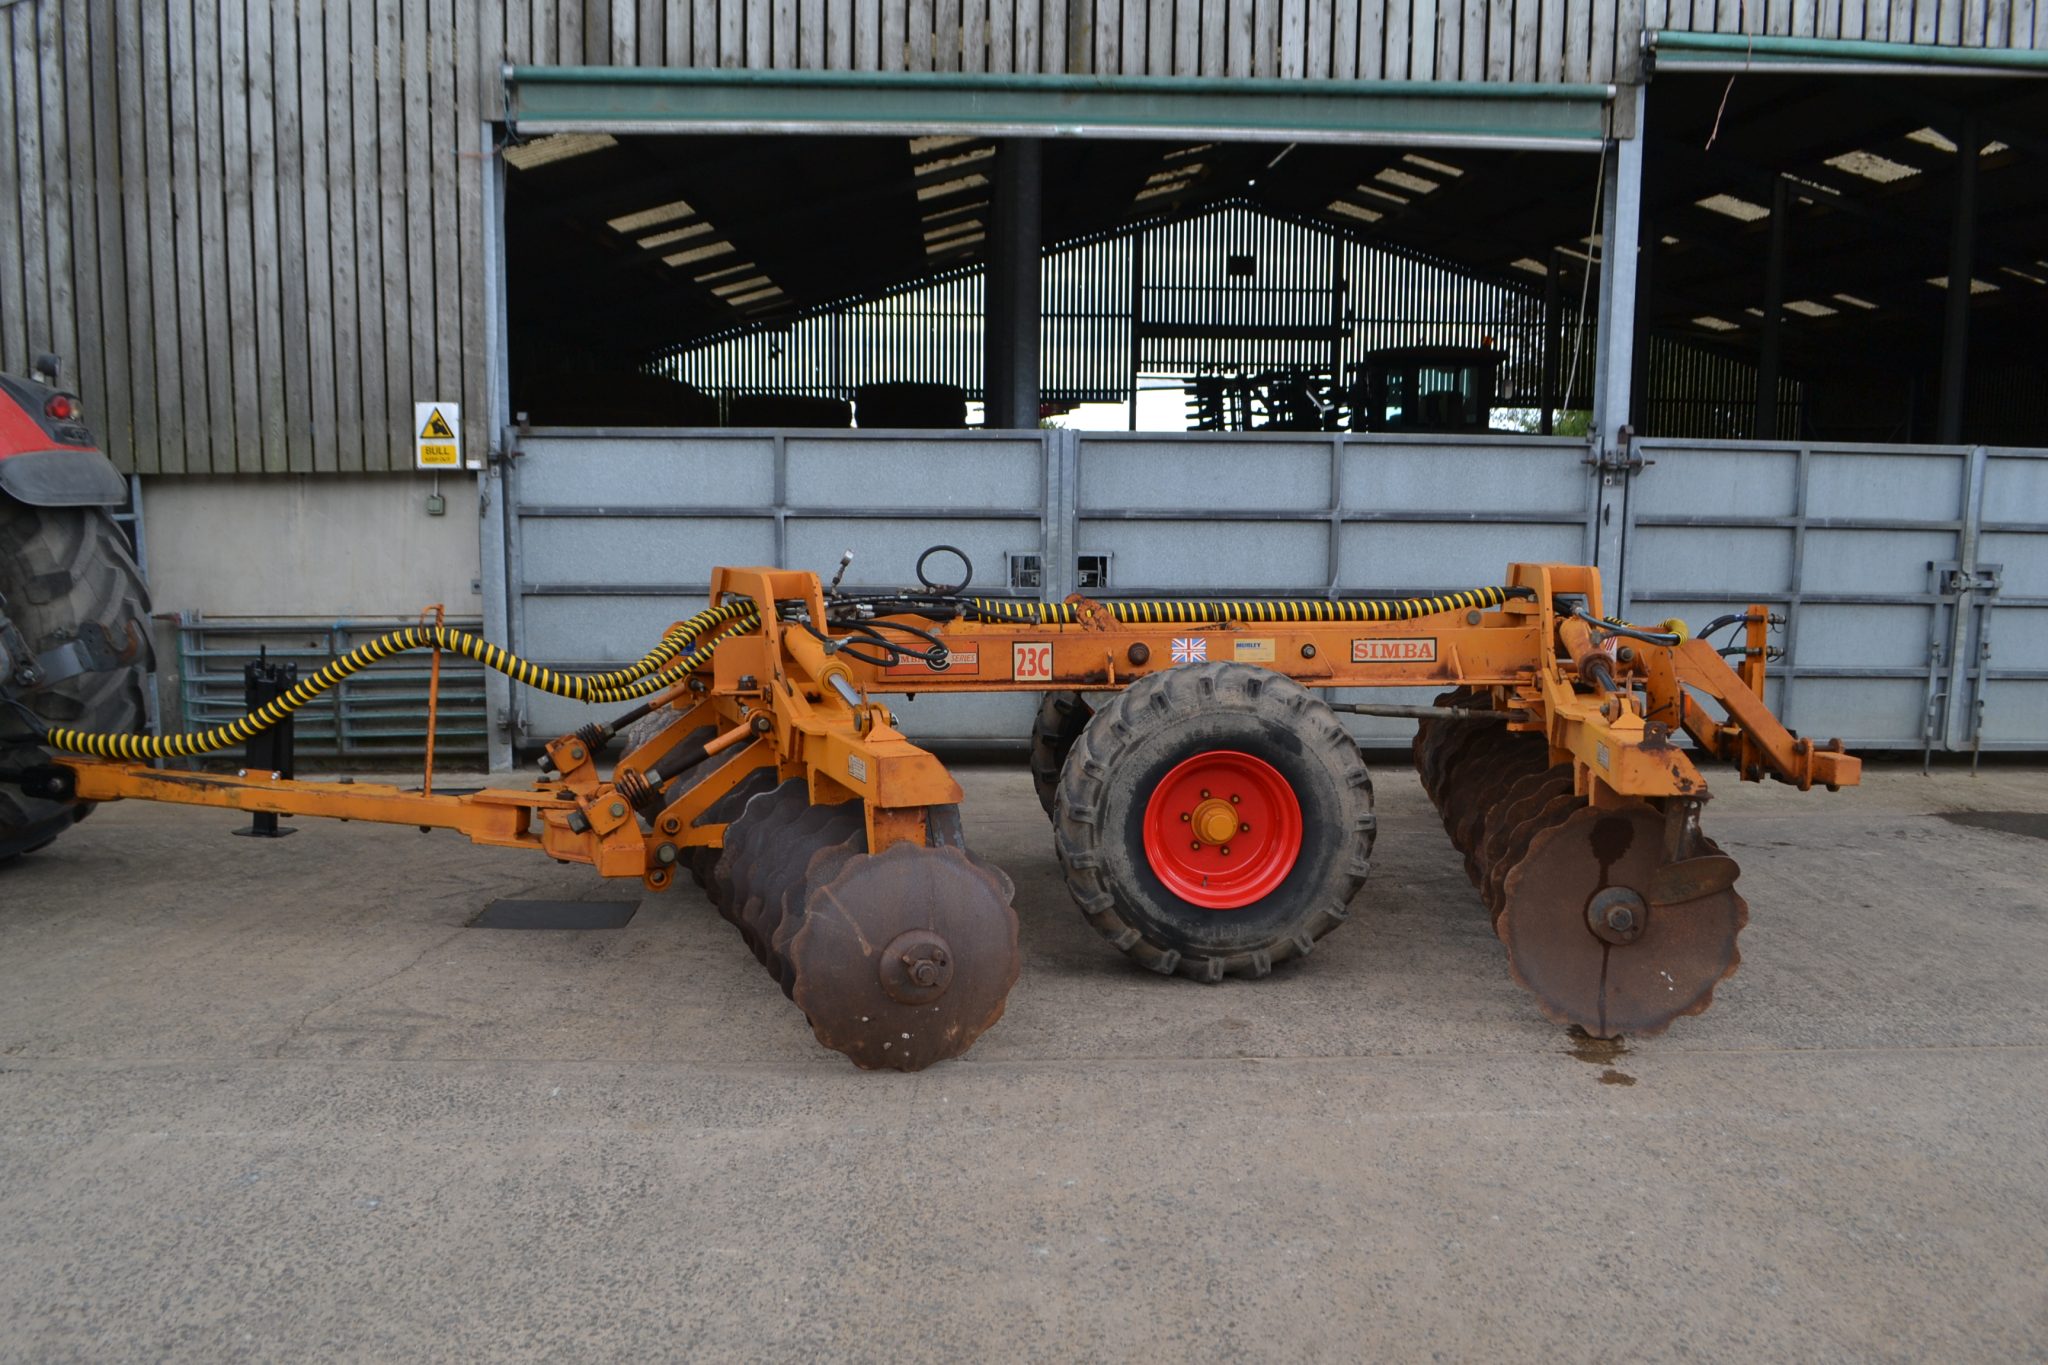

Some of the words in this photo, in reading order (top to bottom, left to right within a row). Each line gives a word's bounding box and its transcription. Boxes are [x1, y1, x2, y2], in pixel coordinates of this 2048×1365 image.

[425, 446, 450, 455] BULL
[1354, 642, 1433, 659] SIMBA
[951, 654, 976, 662] SERIES
[1016, 647, 1050, 677] 23C
